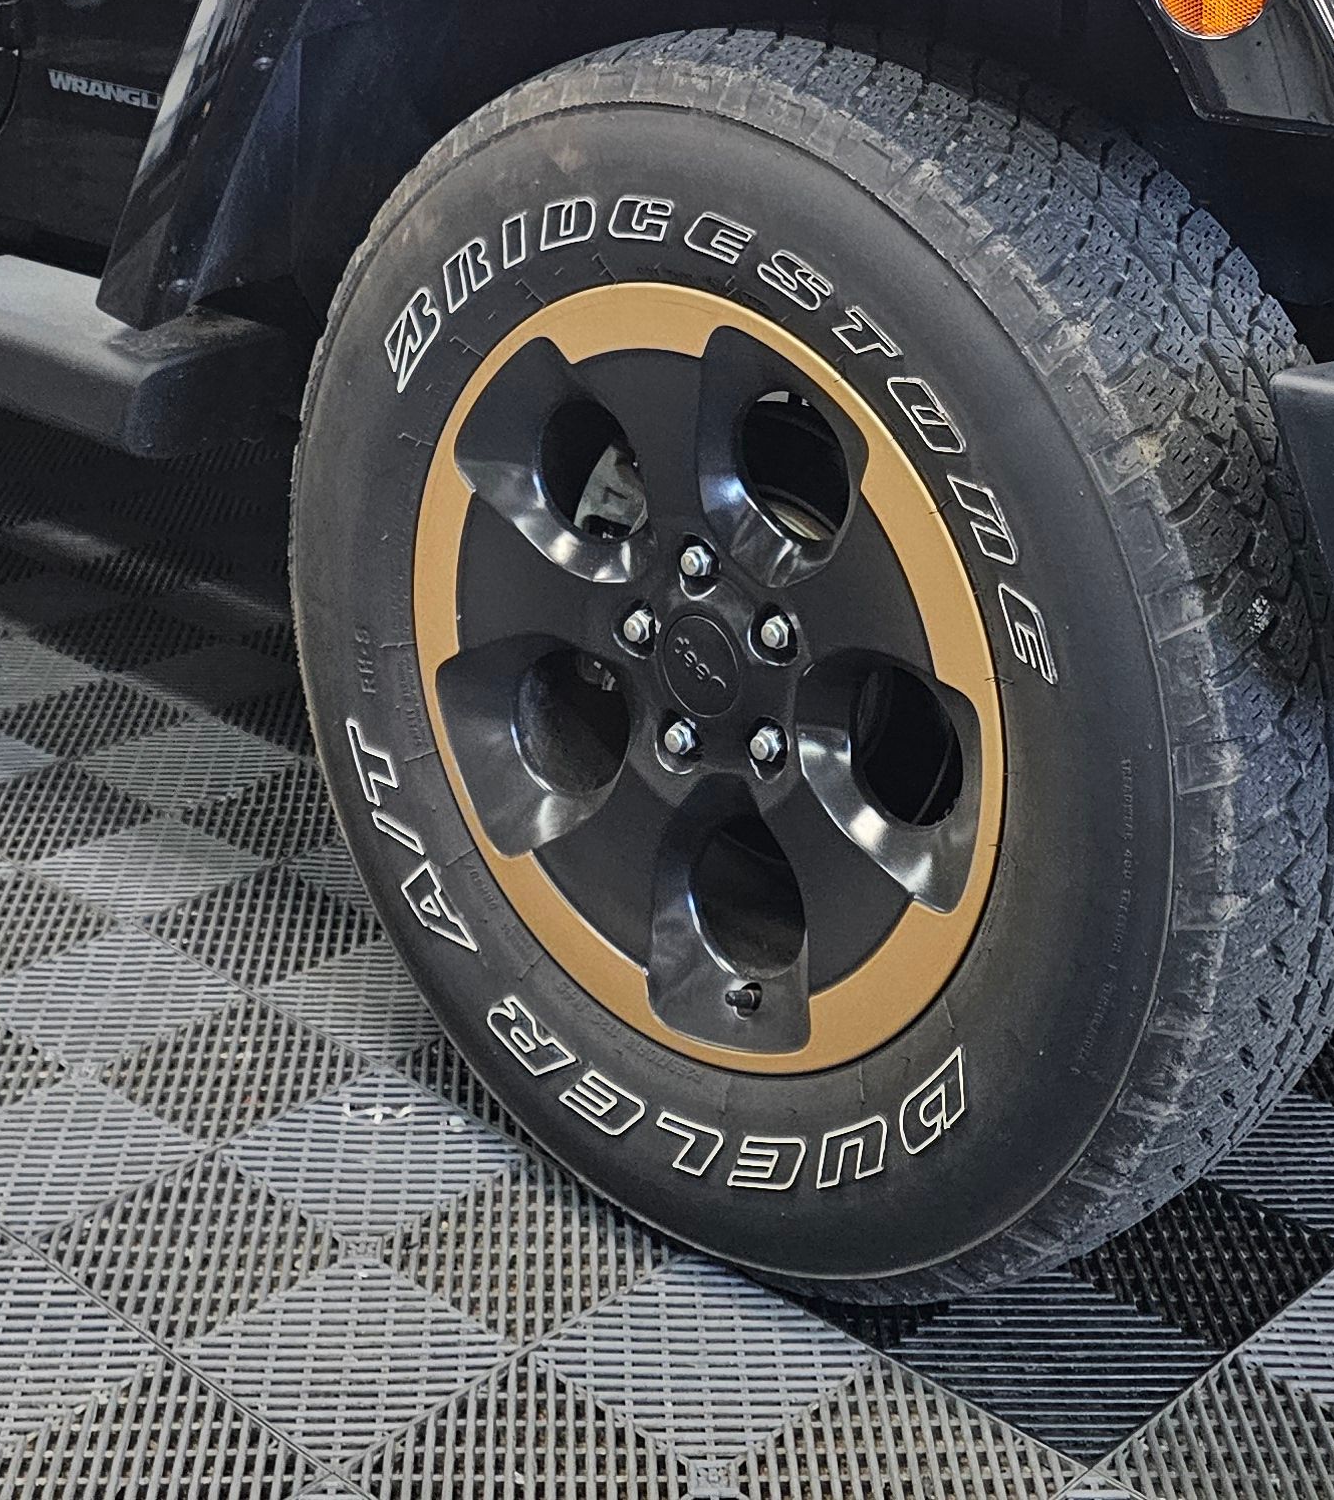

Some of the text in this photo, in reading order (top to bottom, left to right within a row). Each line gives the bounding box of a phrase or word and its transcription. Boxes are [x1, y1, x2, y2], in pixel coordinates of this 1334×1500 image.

[382, 195, 1059, 687] BRIDGESTONE
[346, 718, 478, 953] A/T
[485, 995, 965, 1191] DUELER
